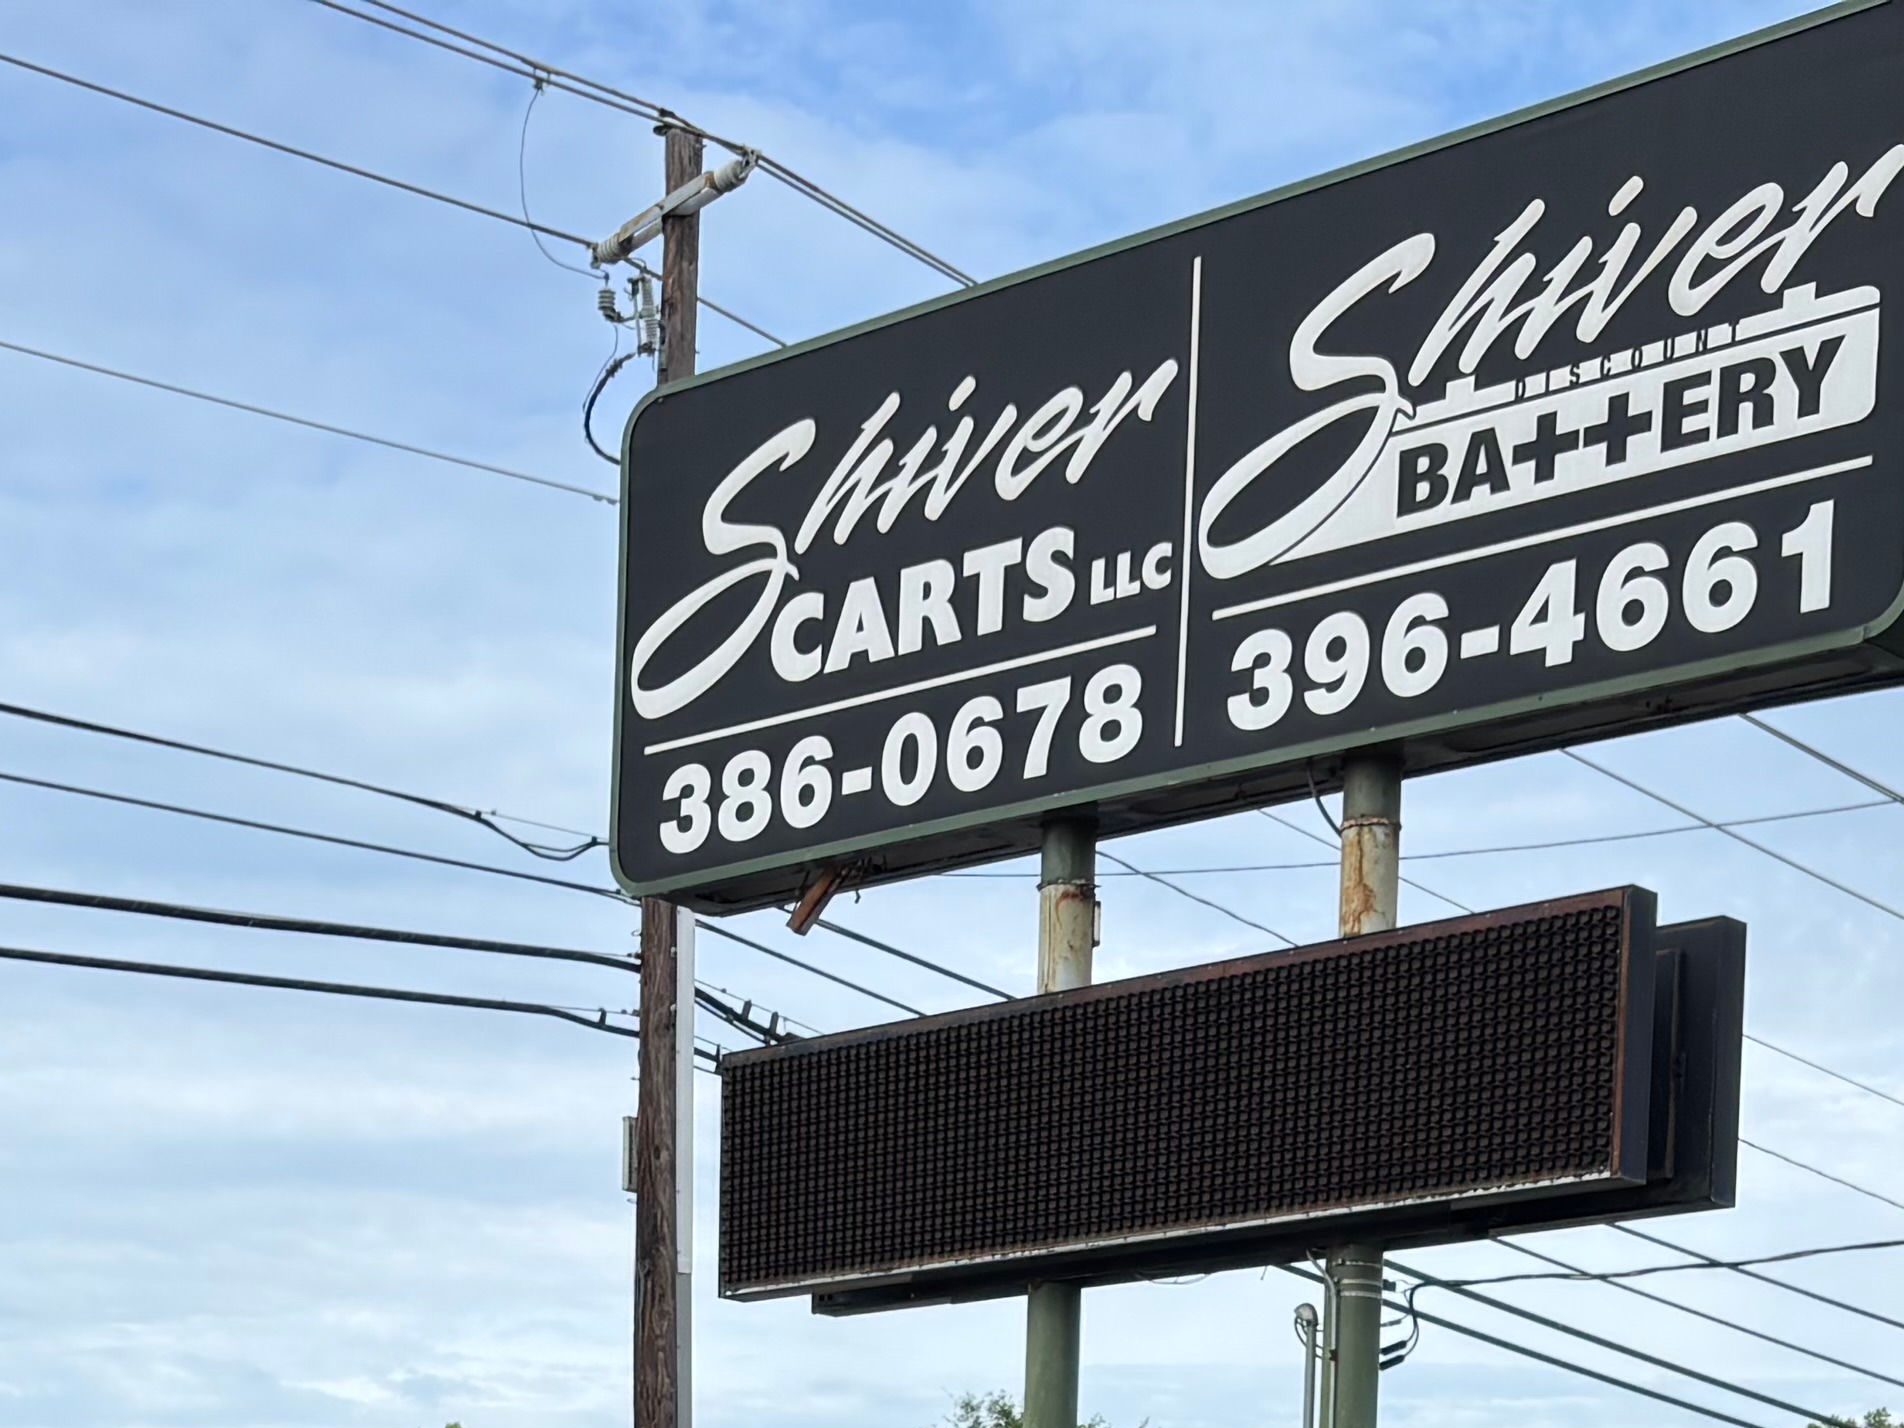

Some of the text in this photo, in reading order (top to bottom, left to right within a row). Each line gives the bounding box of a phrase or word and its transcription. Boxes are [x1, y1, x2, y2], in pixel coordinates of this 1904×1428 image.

[1514, 321, 1740, 401] DISCOUNT
[631, 358, 1179, 720] Shiver
[770, 526, 1173, 682] CARTS LLC
[1226, 499, 1835, 732] 396-4661
[658, 662, 1144, 855] 386-0678
